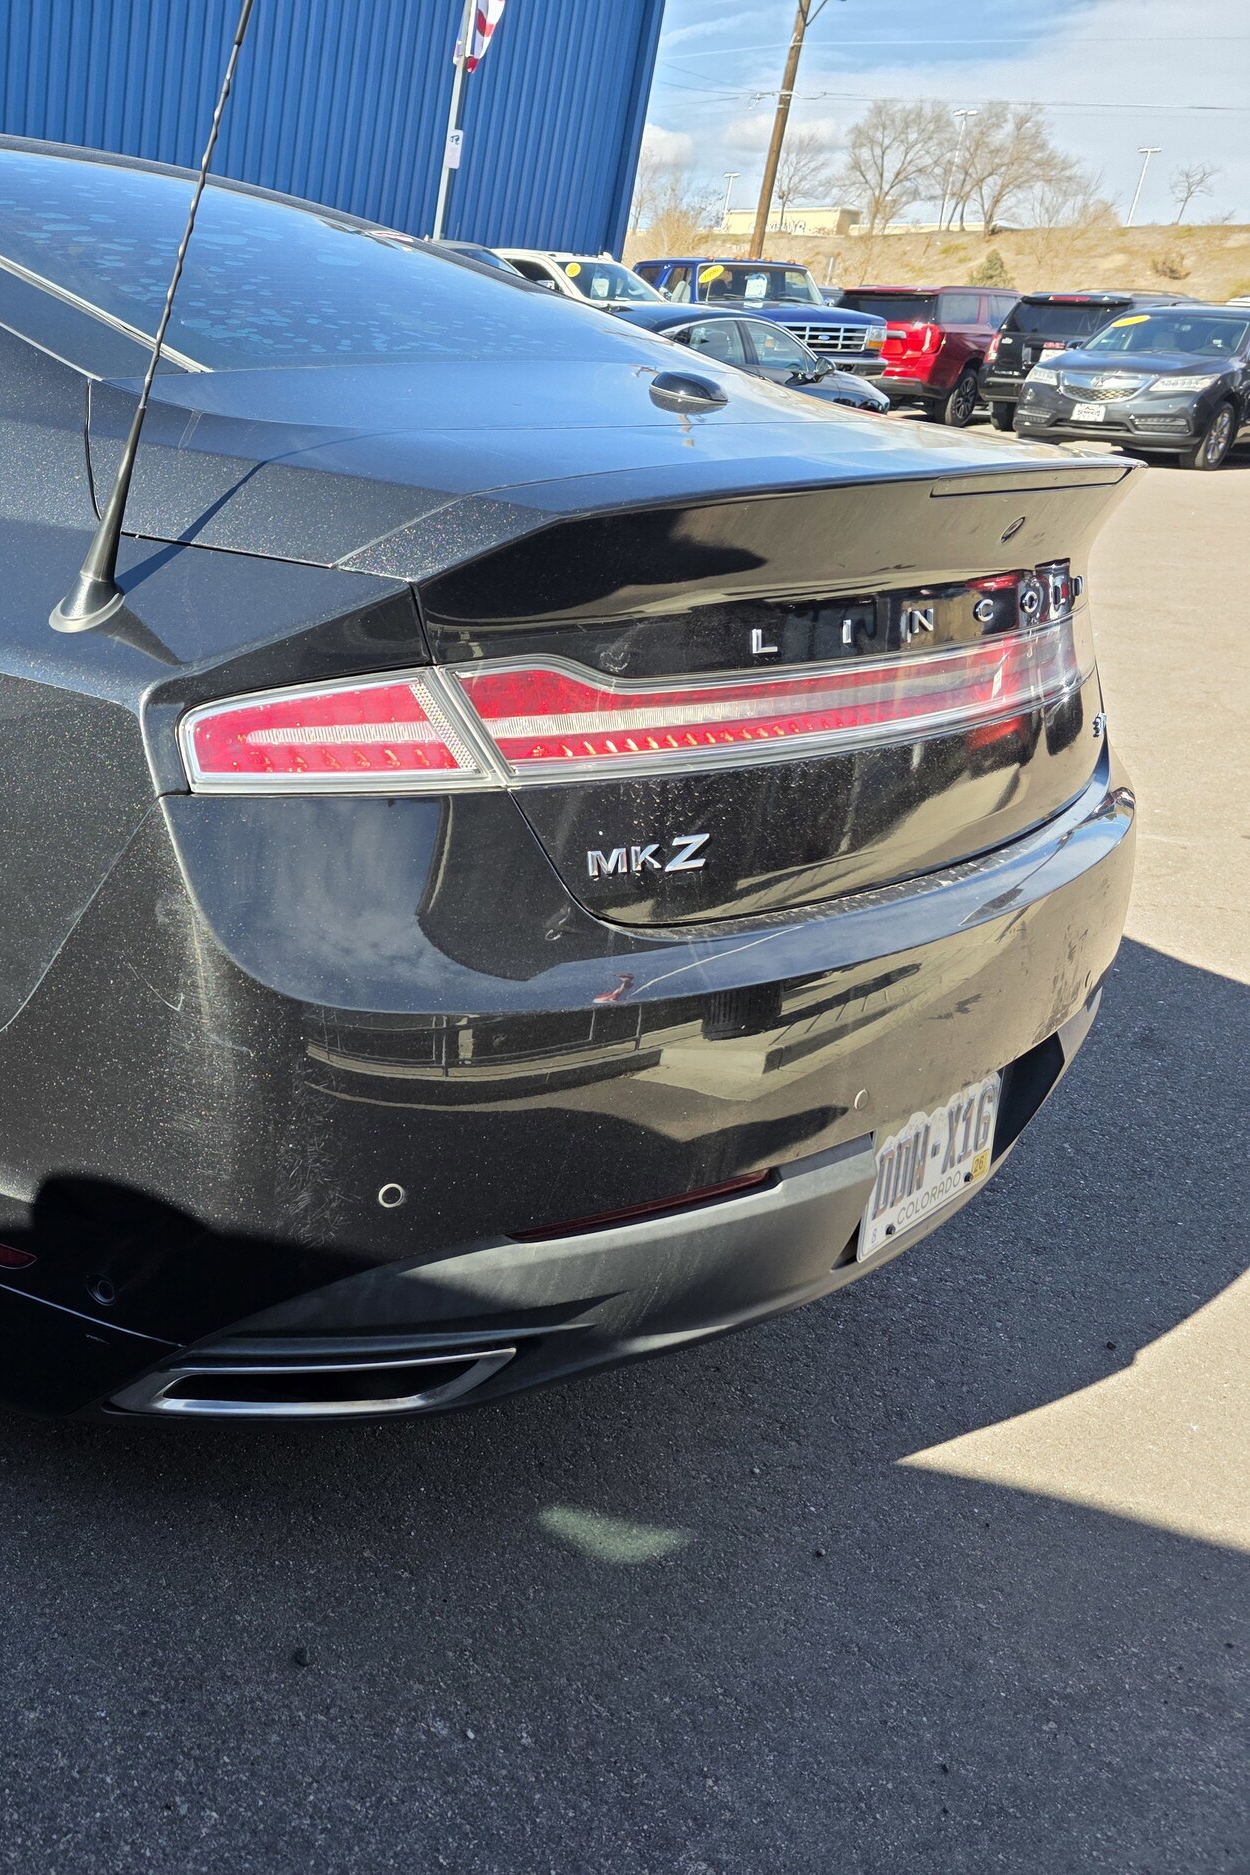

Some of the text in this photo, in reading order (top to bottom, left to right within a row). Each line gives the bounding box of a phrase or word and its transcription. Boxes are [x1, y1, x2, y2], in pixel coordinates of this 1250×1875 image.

[1042, 341, 1066, 349] GMC
[587, 833, 710, 877] MKZ
[973, 1155, 984, 1173] 26
[896, 1170, 961, 1225] COLORADO
